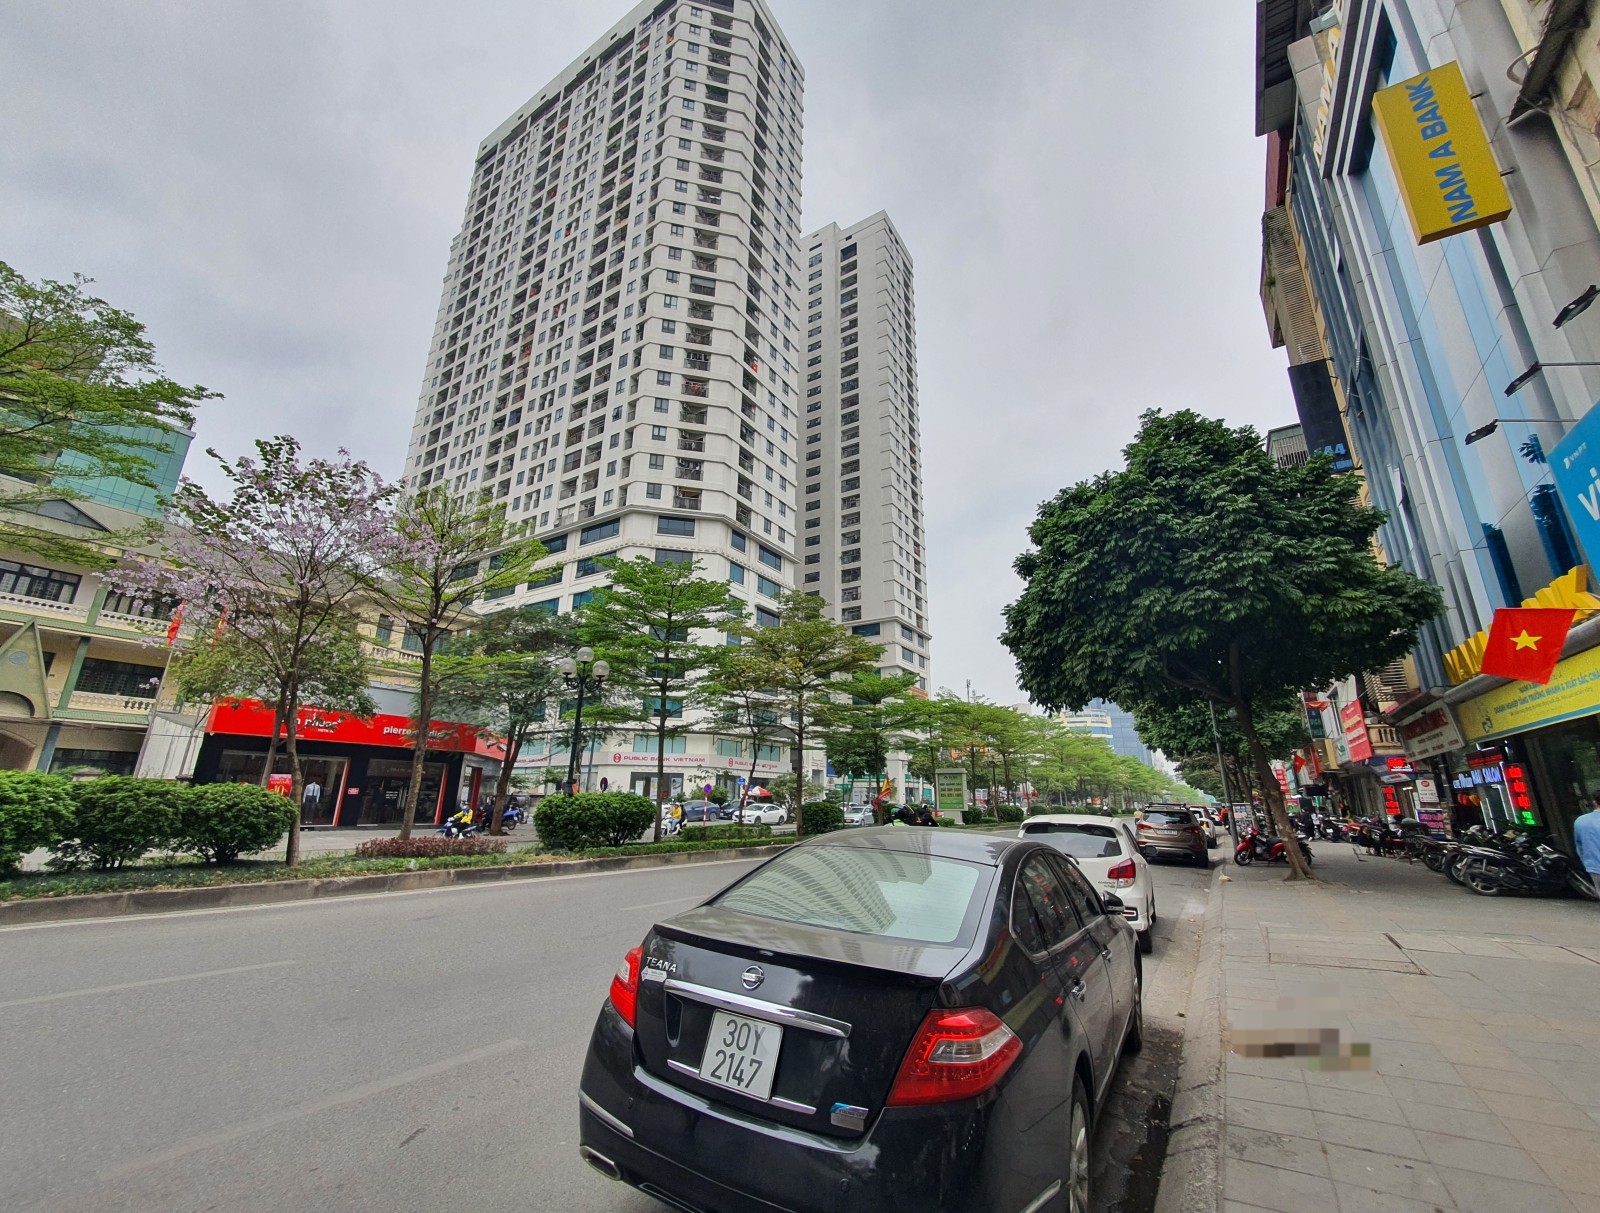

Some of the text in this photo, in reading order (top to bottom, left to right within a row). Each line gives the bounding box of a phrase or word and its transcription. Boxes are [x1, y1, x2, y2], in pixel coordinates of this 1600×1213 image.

[1405, 76, 1478, 224] NAM A BANK
[1569, 442, 1587, 462] VNPT
[383, 725, 412, 735] pierre
[646, 956, 677, 973] TEANA
[722, 1019, 766, 1055] 30Y
[710, 1049, 763, 1089] 2147
